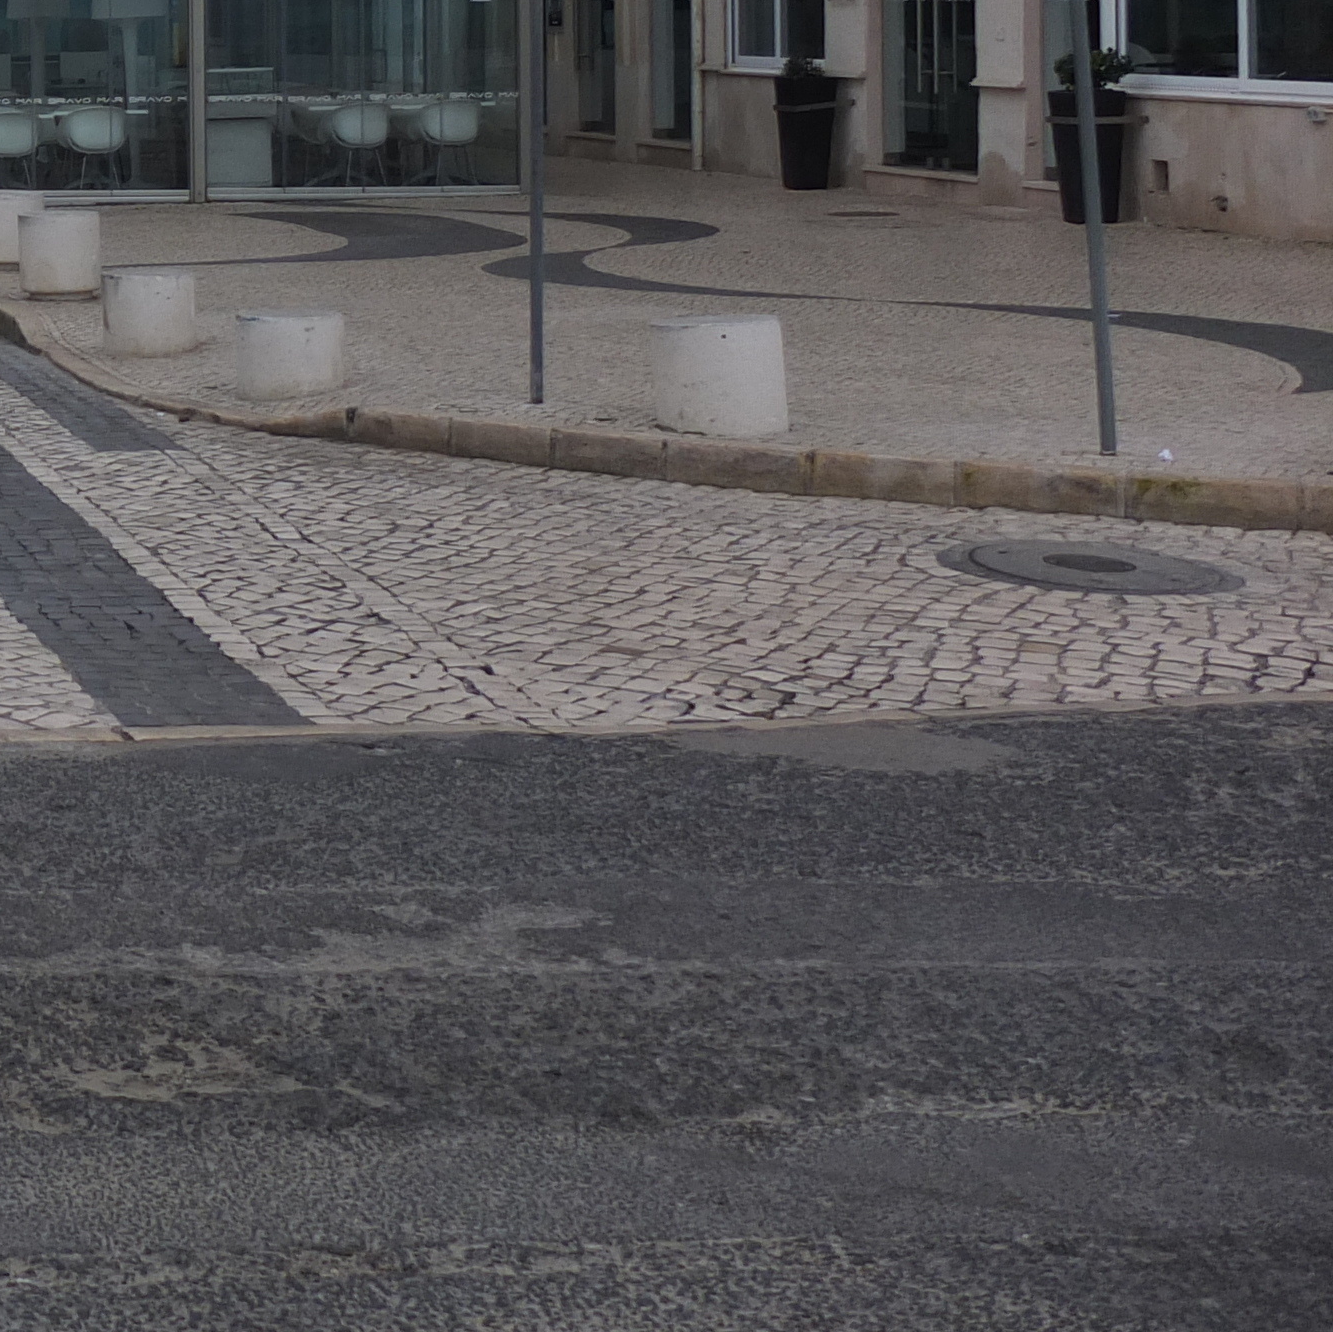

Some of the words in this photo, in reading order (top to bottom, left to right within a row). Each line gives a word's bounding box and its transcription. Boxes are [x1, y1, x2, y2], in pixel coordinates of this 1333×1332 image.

[449, 91, 494, 99] BRAVO
[47, 97, 92, 105] BRAVO
[129, 96, 172, 104] BRAVO
